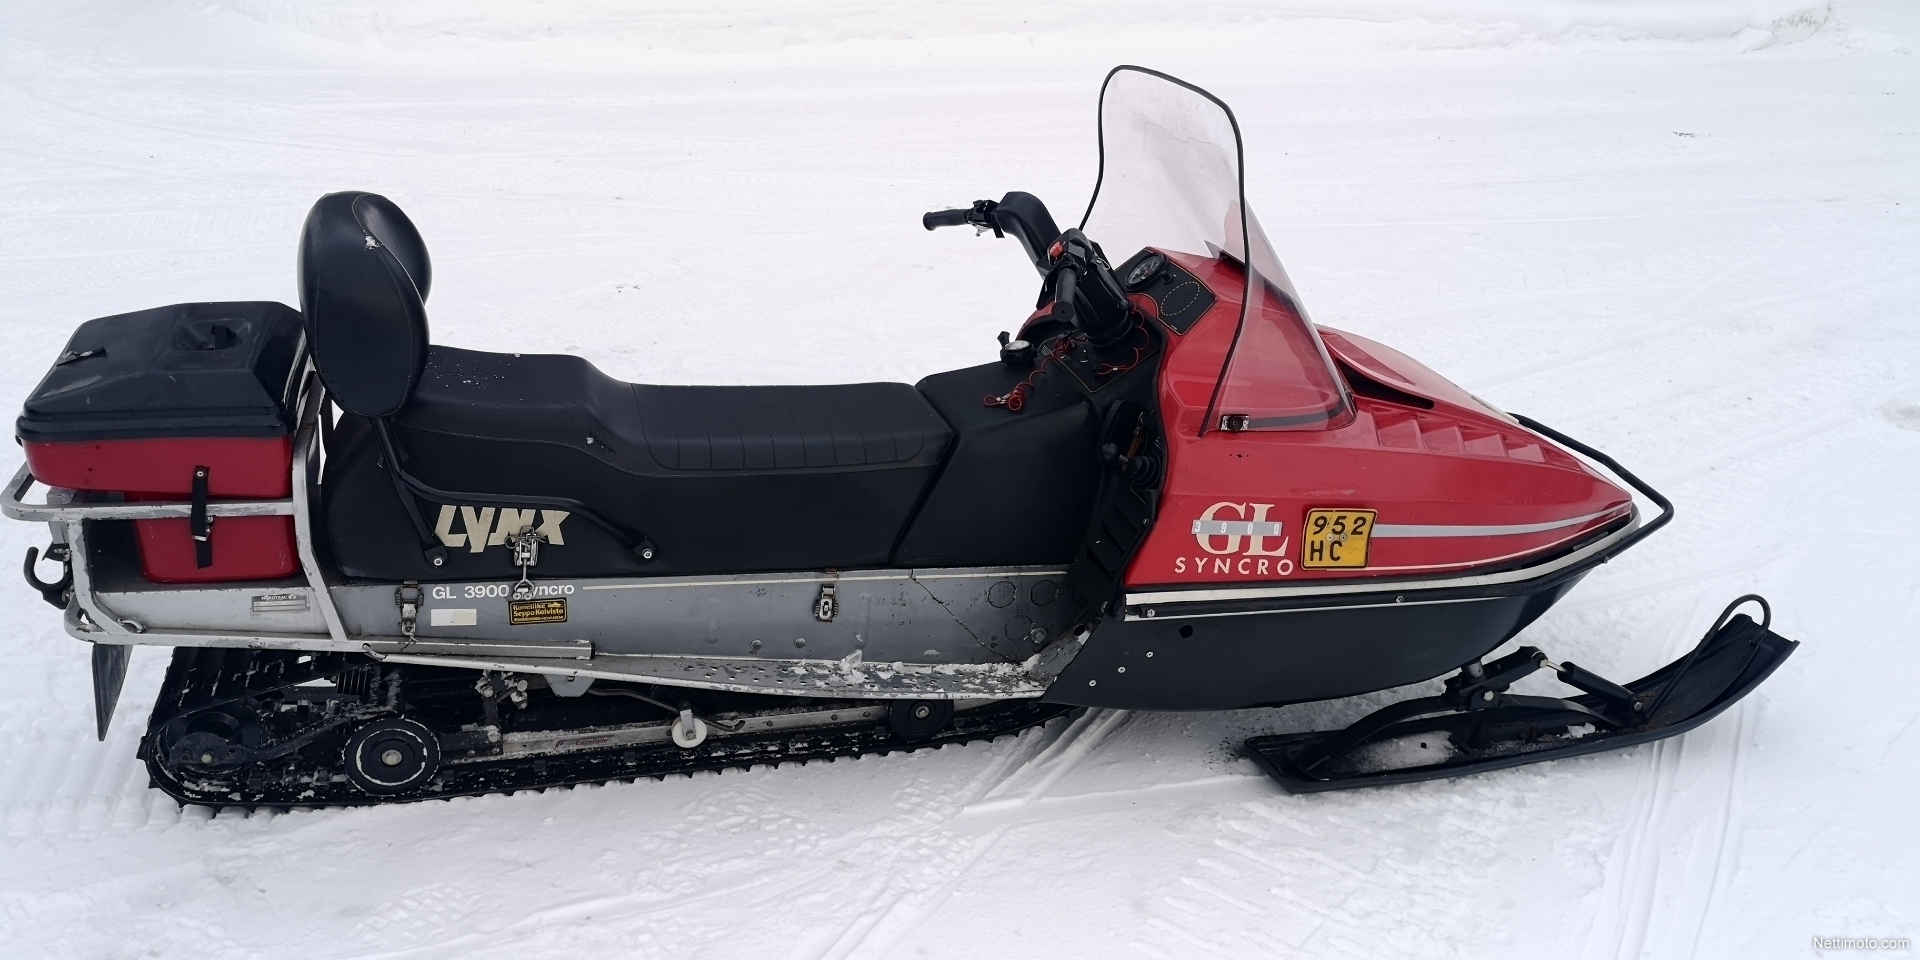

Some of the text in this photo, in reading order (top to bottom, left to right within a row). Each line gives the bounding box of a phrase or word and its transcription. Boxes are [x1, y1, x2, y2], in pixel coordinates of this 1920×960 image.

[434, 504, 571, 554] LYNX
[1194, 521, 1280, 536] 3900
[1195, 501, 1289, 557] GL
[1312, 515, 1367, 536] 952
[1309, 539, 1343, 562] HC
[1174, 556, 1294, 576] SYNCRO
[432, 584, 575, 599] GL 3900 yncro
[513, 607, 564, 618] Seppo Koivisto
